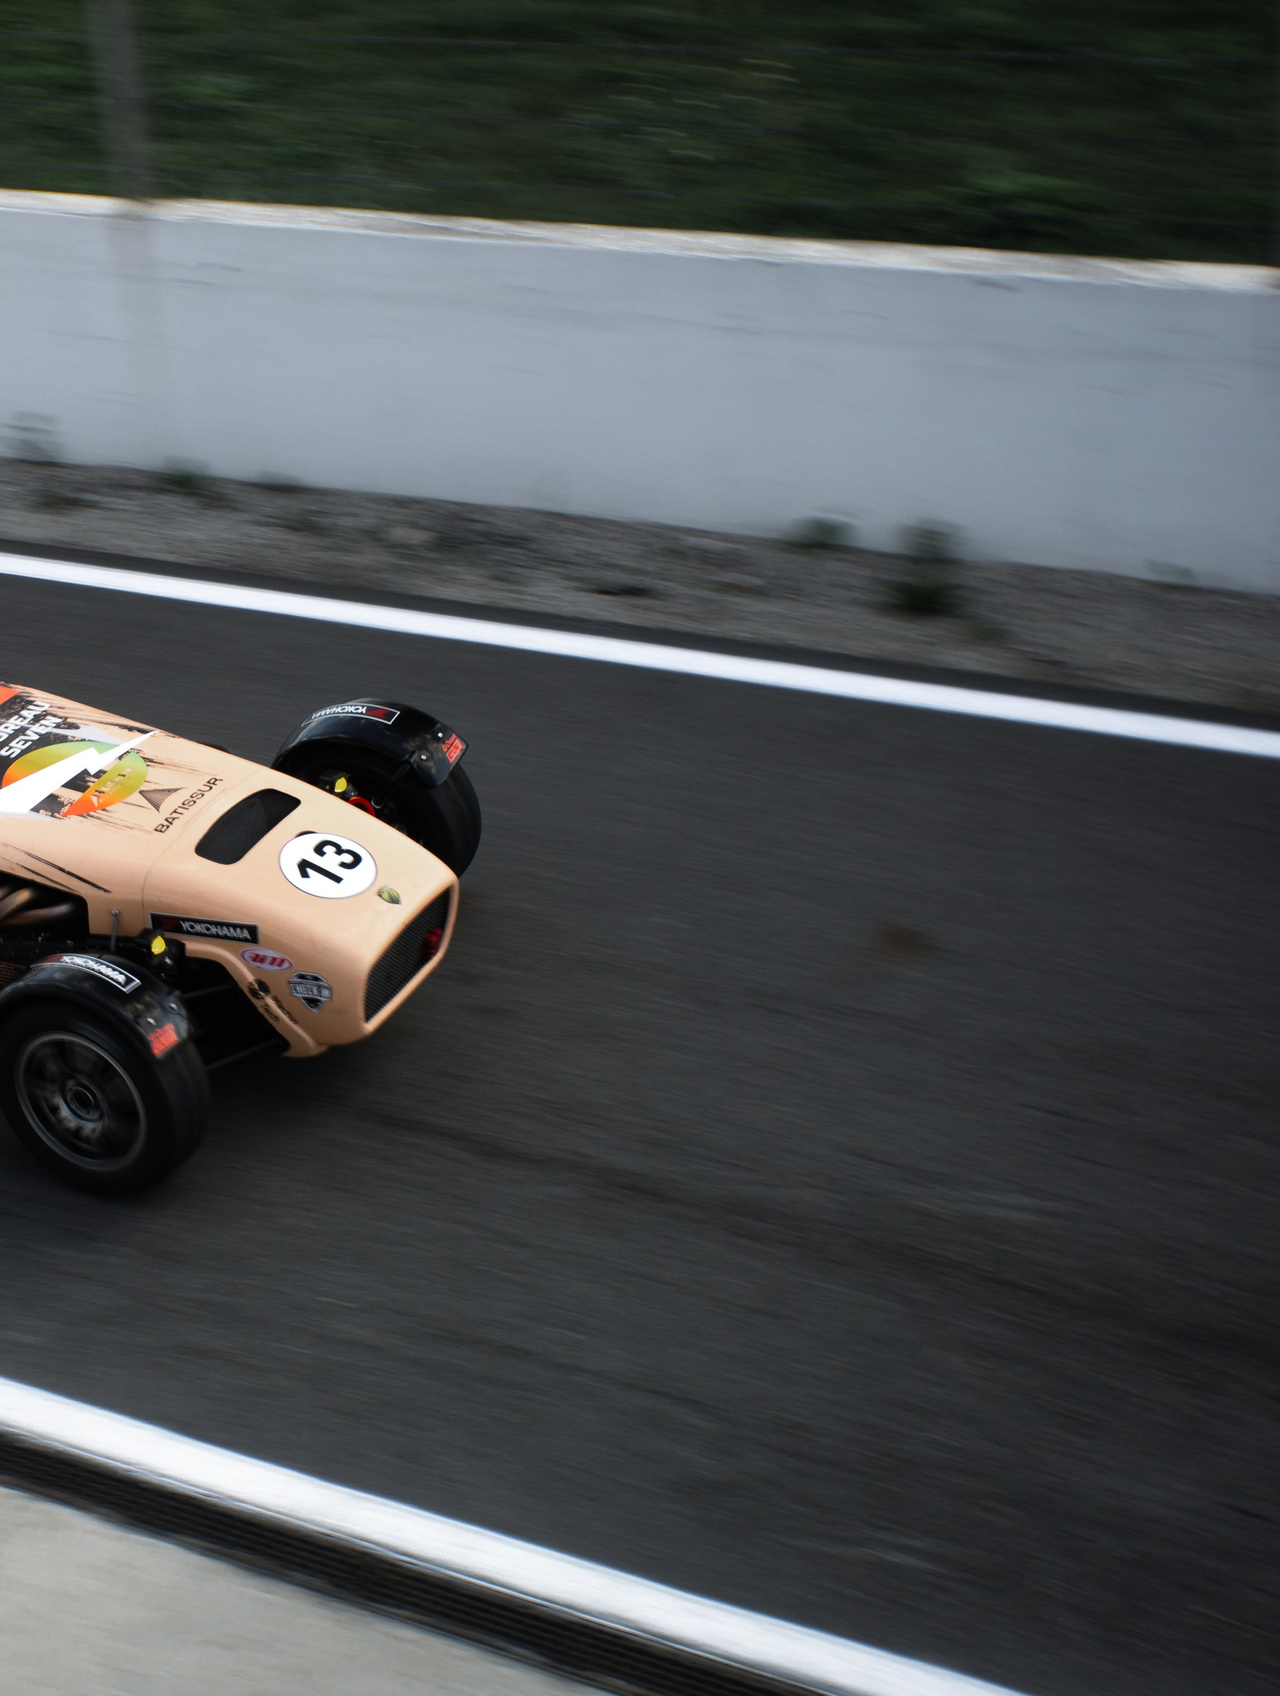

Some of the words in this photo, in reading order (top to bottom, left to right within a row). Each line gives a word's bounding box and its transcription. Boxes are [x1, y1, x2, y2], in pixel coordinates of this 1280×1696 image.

[0, 716, 64, 759] SEVEN
[153, 777, 223, 833] BATISSUR
[296, 839, 363, 884] 13
[179, 920, 251, 940] YOKOHAMA
